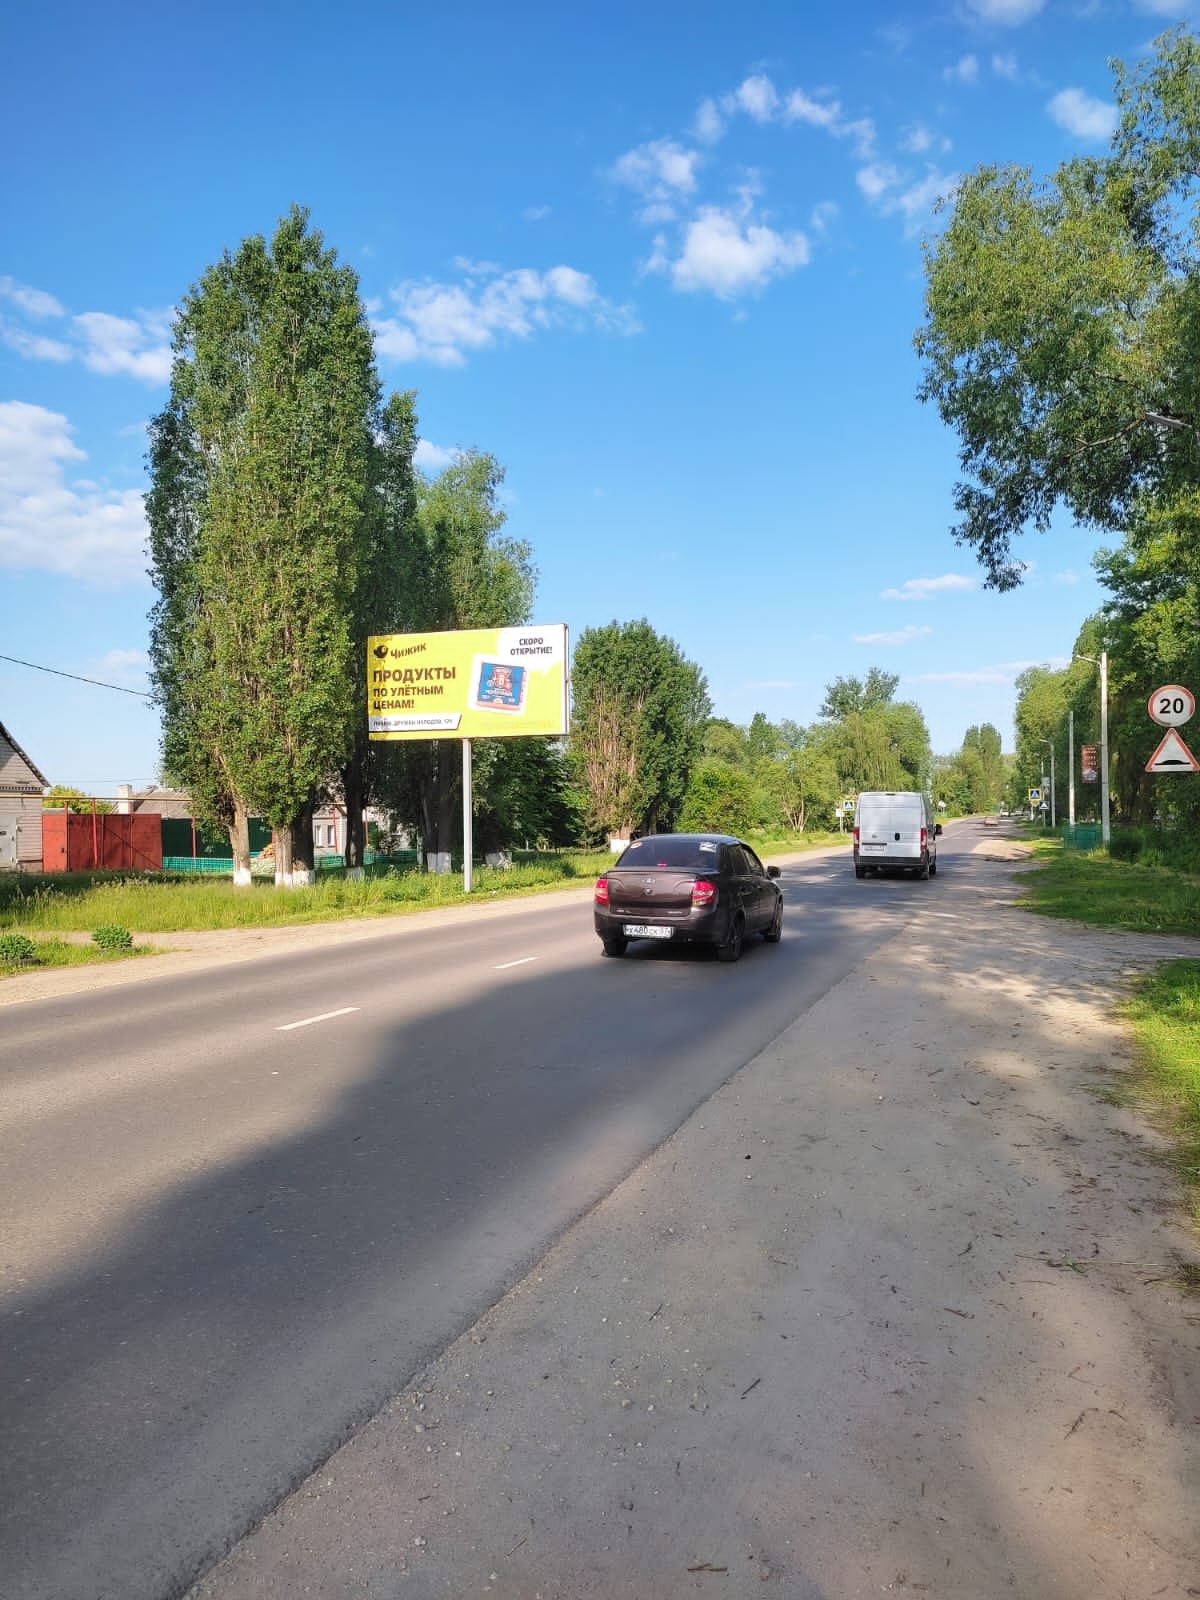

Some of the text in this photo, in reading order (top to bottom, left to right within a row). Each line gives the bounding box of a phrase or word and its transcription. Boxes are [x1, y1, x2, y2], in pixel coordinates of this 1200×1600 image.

[519, 637, 544, 646] СКОРО
[510, 646, 553, 656] ОТКРЫТИЕ!
[373, 666, 456, 684] ПРОДУКТЫ
[373, 684, 444, 698] ПО УЛЁТНЫМ
[373, 699, 415, 711] ЦЕНАМ!
[1159, 698, 1184, 714] 20
